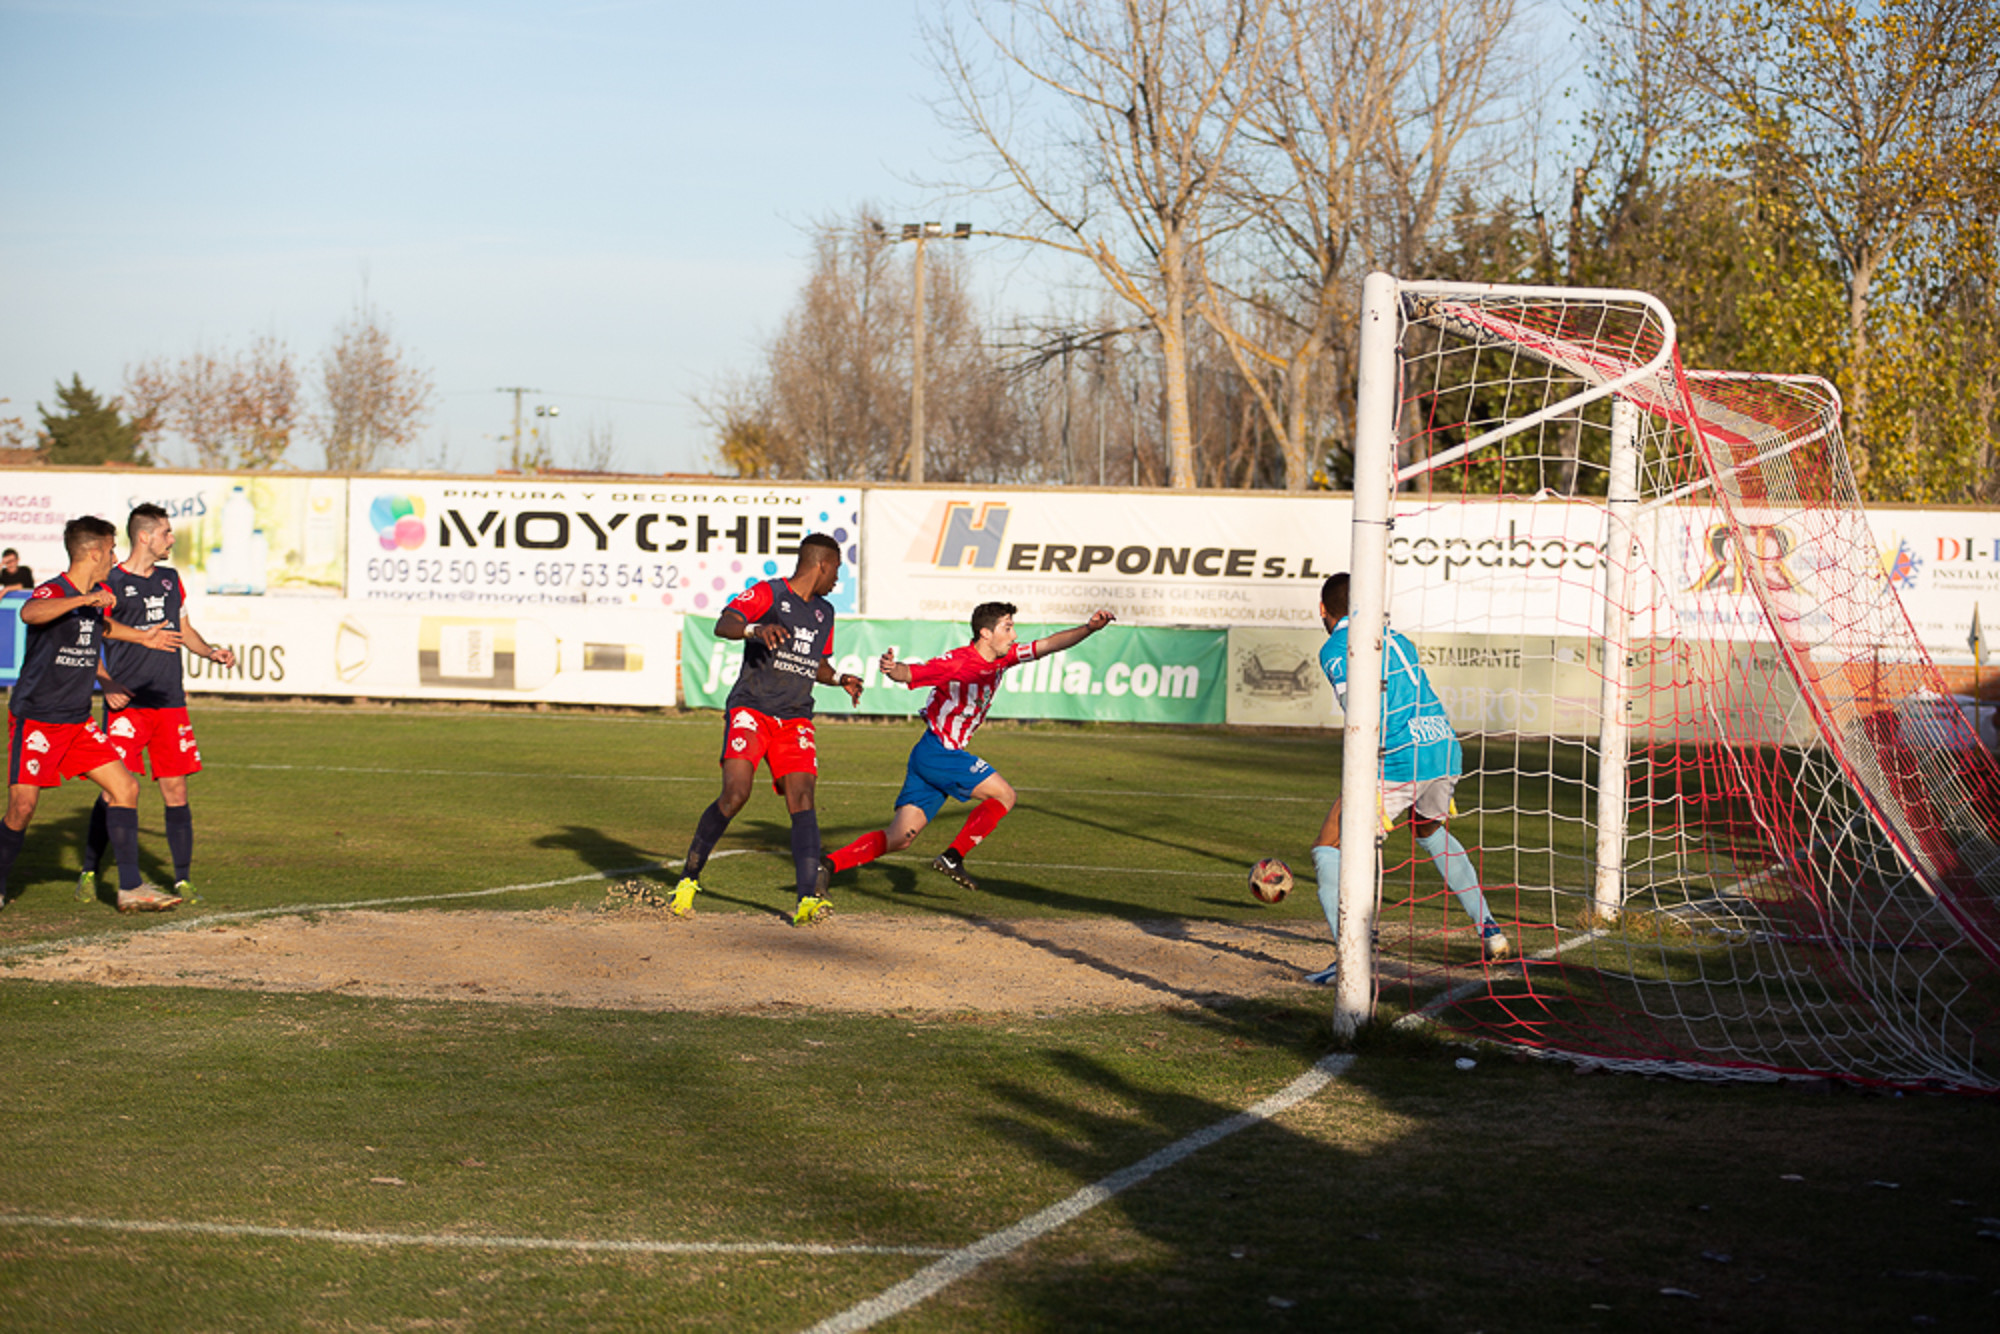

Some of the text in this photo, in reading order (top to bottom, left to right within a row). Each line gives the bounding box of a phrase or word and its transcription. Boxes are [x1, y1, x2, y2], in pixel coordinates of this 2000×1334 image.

[443, 489, 802, 505] PINTURA Y DECORACIÓN
[439, 508, 803, 555] MOYCHE
[368, 557, 410, 583] 609
[416, 559, 443, 583] 52
[450, 560, 478, 584] 50
[484, 561, 511, 585] 95
[534, 562, 576, 587] 687
[581, 563, 610, 588] 53
[616, 563, 644, 588] 54
[651, 565, 679, 589] 32
[1262, 556, 1332, 579] S.L.
[368, 589, 622, 605] moyche@moychesl.es
[976, 583, 1251, 602] CONSTRUCCIONES EN GENERAL
[1417, 646, 1521, 668] ESTAURANTE
